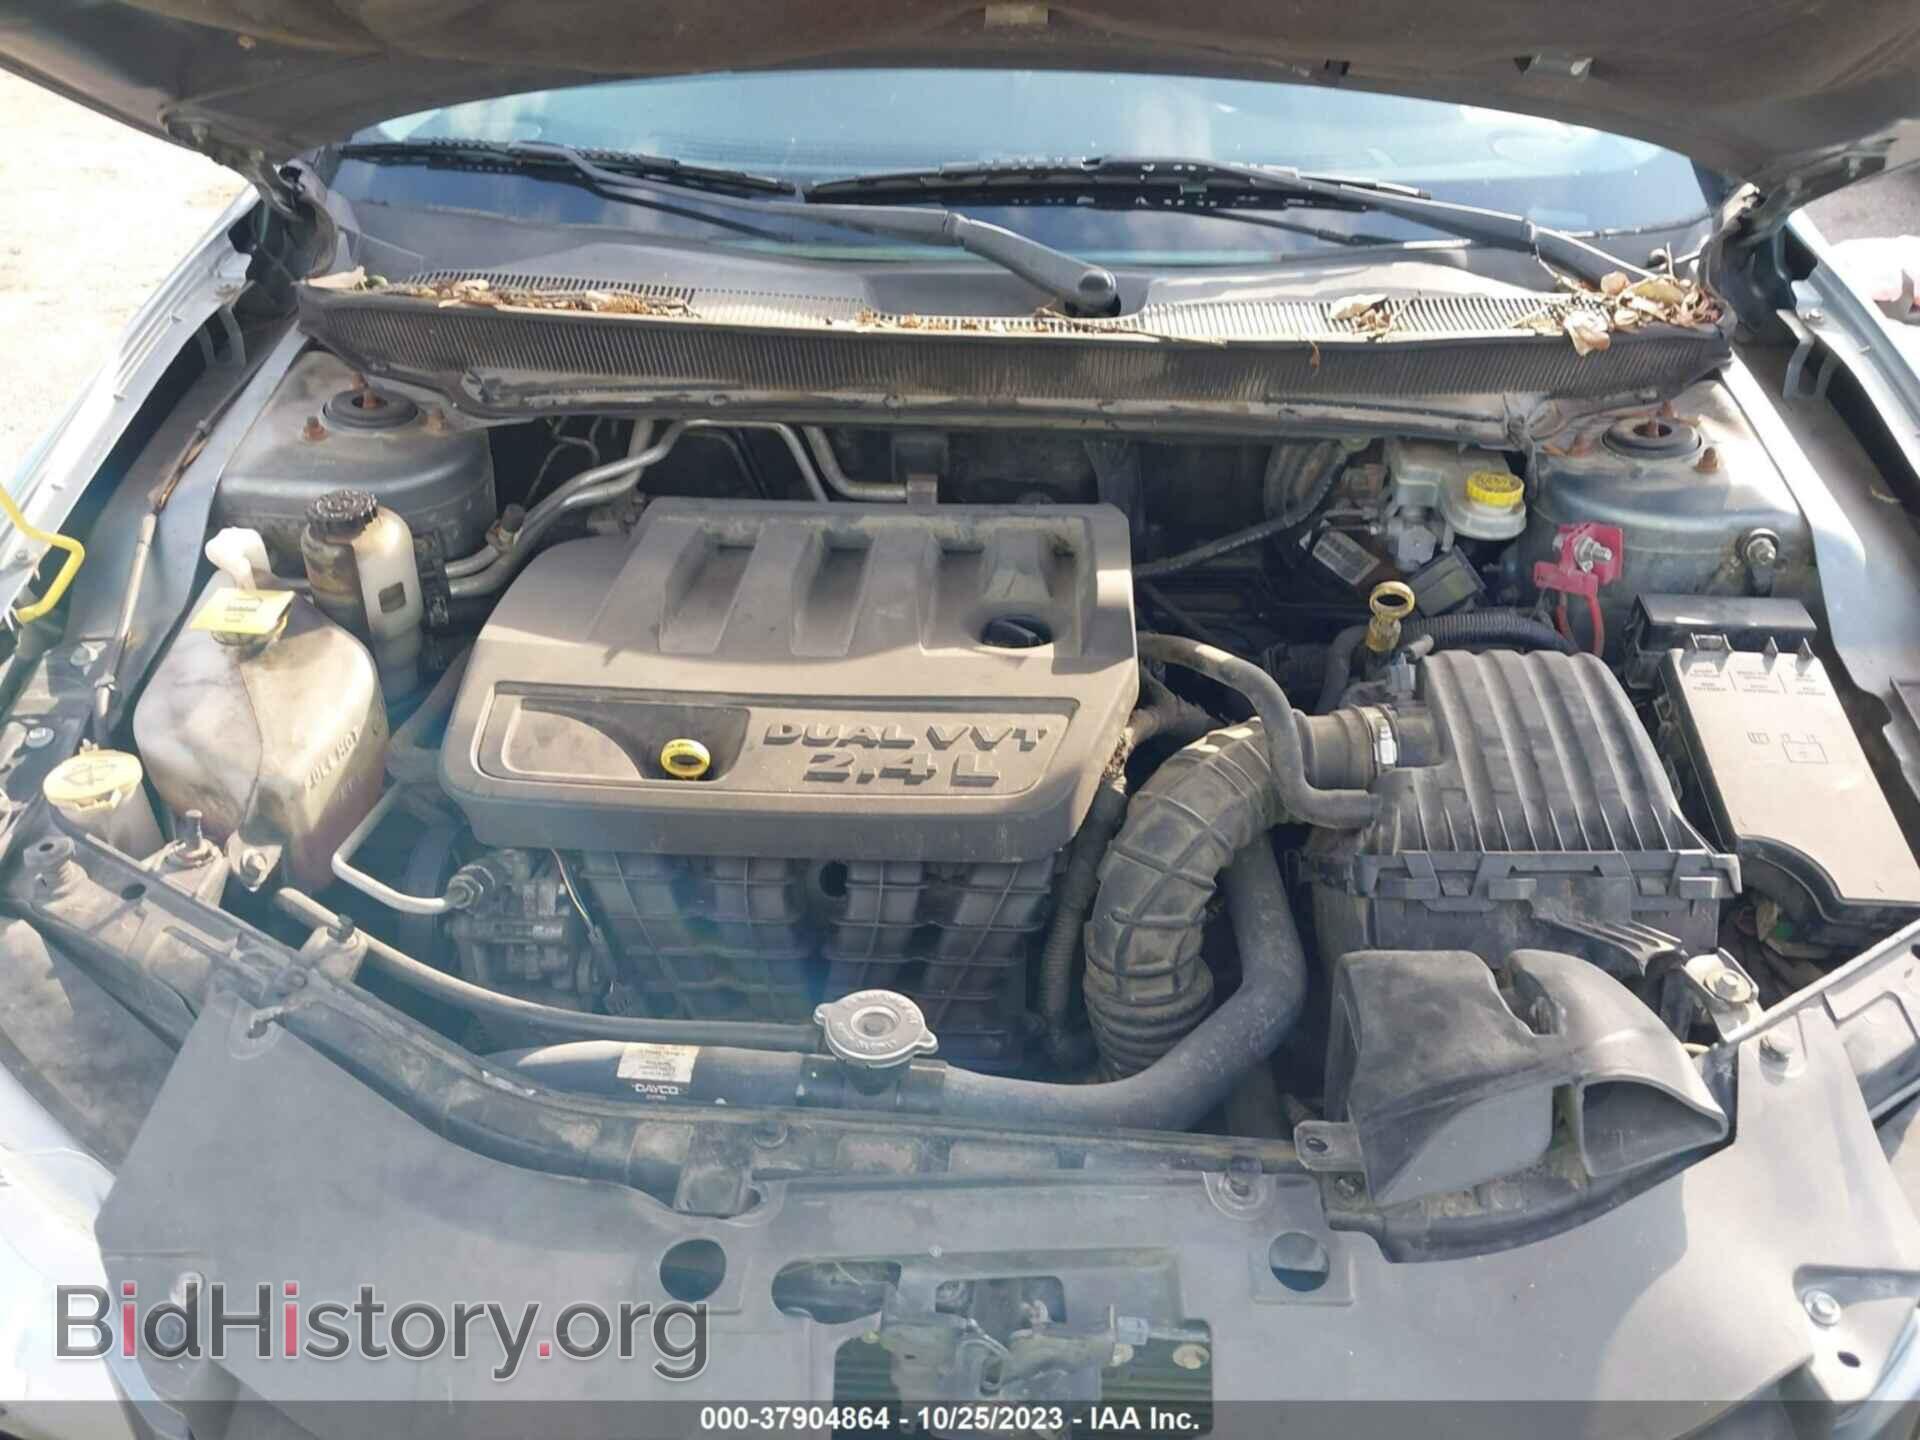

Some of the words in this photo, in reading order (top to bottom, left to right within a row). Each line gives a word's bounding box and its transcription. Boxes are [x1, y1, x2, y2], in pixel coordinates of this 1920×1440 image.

[763, 722, 917, 749] DUAL
[926, 723, 1048, 751] VVT
[950, 752, 1000, 788] L
